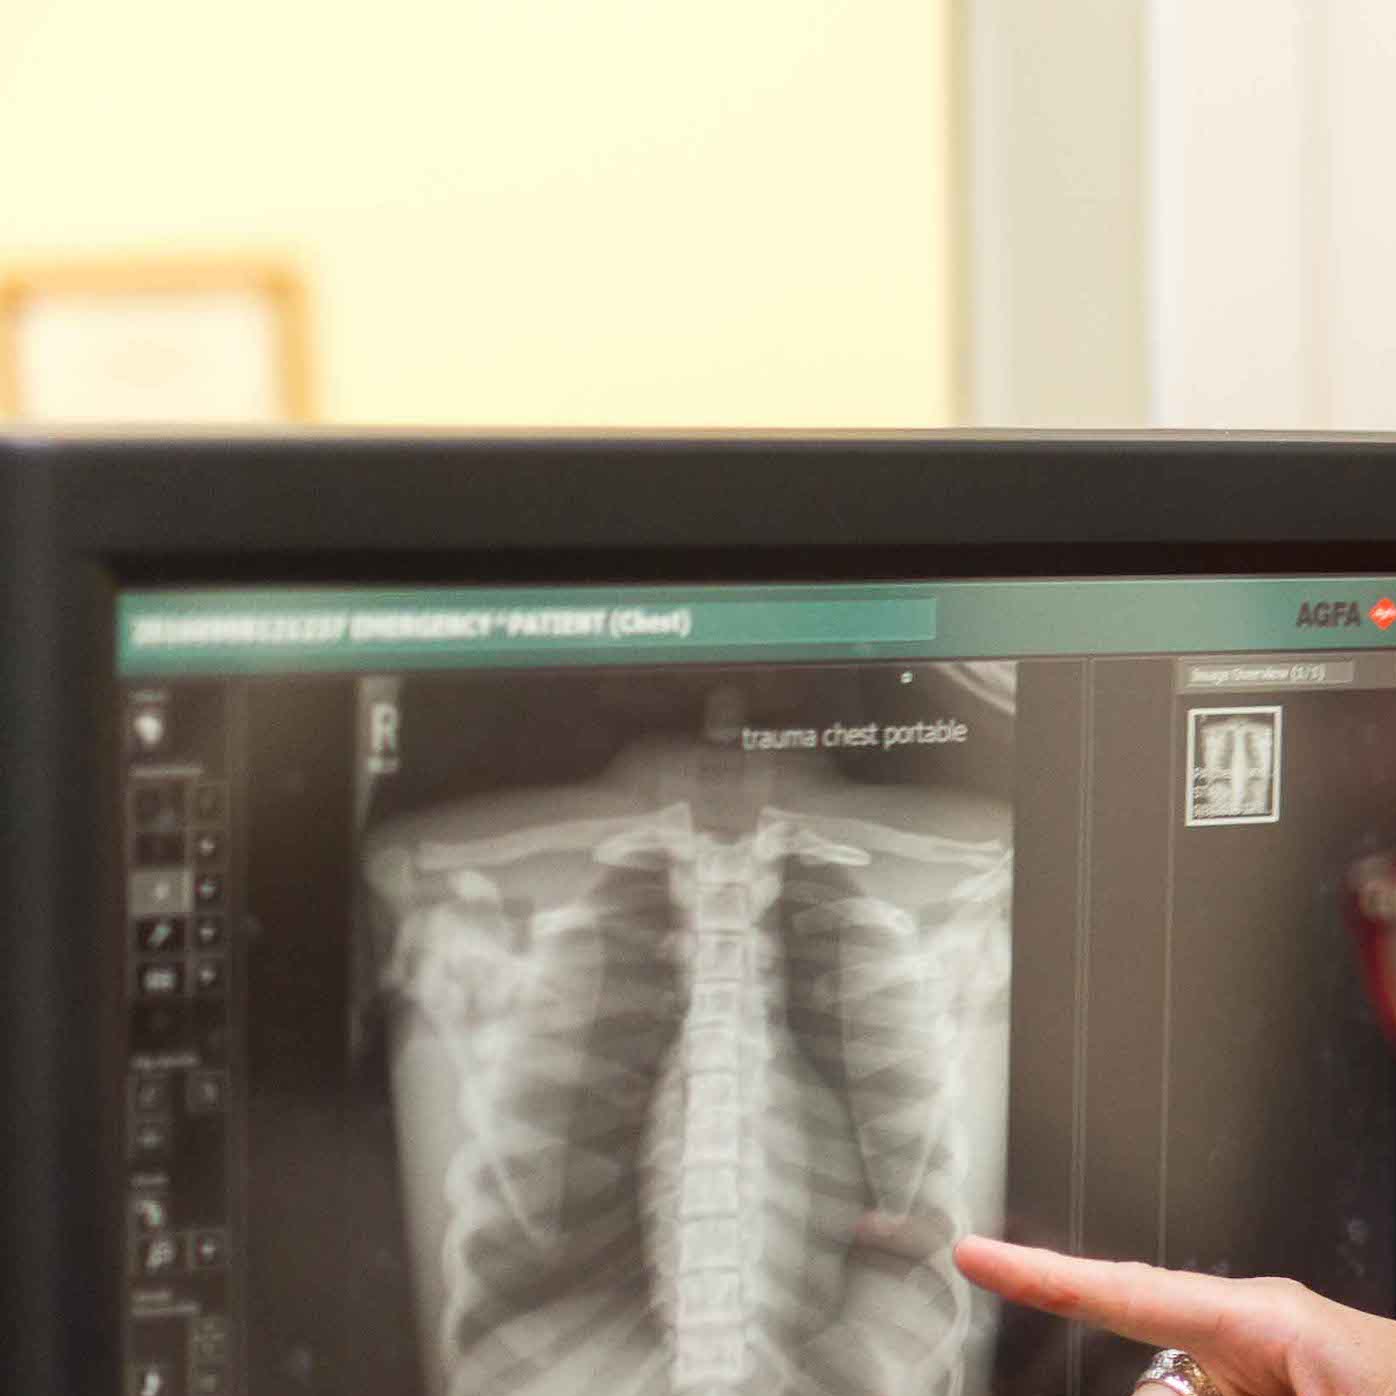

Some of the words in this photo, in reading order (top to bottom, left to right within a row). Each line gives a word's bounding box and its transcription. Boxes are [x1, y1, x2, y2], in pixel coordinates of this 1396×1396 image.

[1296, 602, 1361, 627] AGFA
[371, 702, 398, 753] R
[742, 717, 817, 750] trauma
[822, 711, 879, 747] chest
[883, 709, 969, 750] portable
